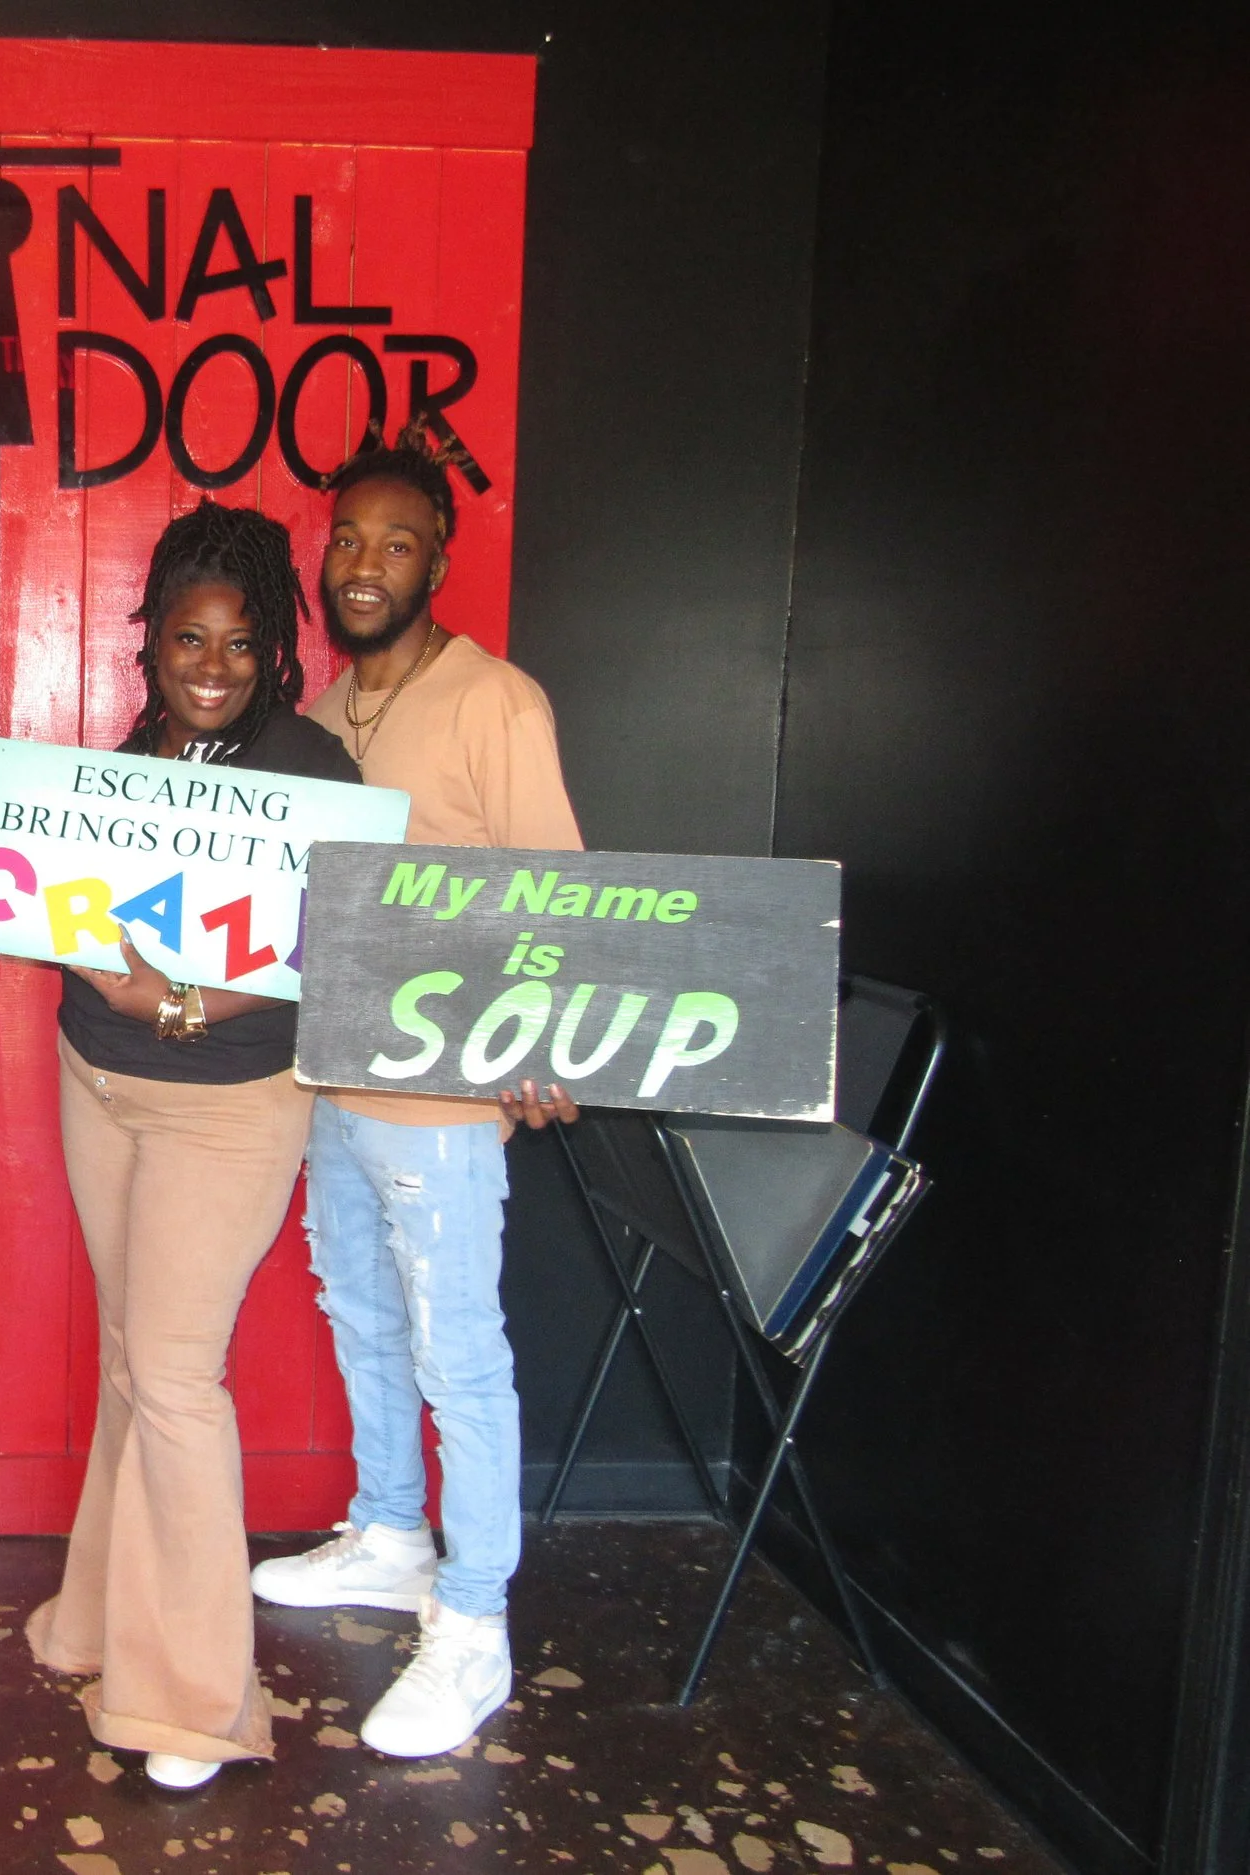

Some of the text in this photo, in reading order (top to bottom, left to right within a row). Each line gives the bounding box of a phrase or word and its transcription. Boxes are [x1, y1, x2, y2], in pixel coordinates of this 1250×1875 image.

[57, 330, 492, 495] DOOR
[71, 764, 291, 823] ESCAPING
[172, 826, 266, 867] OUT
[279, 841, 310, 875] M
[380, 862, 699, 925] My Name
[501, 932, 565, 977] is
[367, 970, 740, 1098] SOUP
